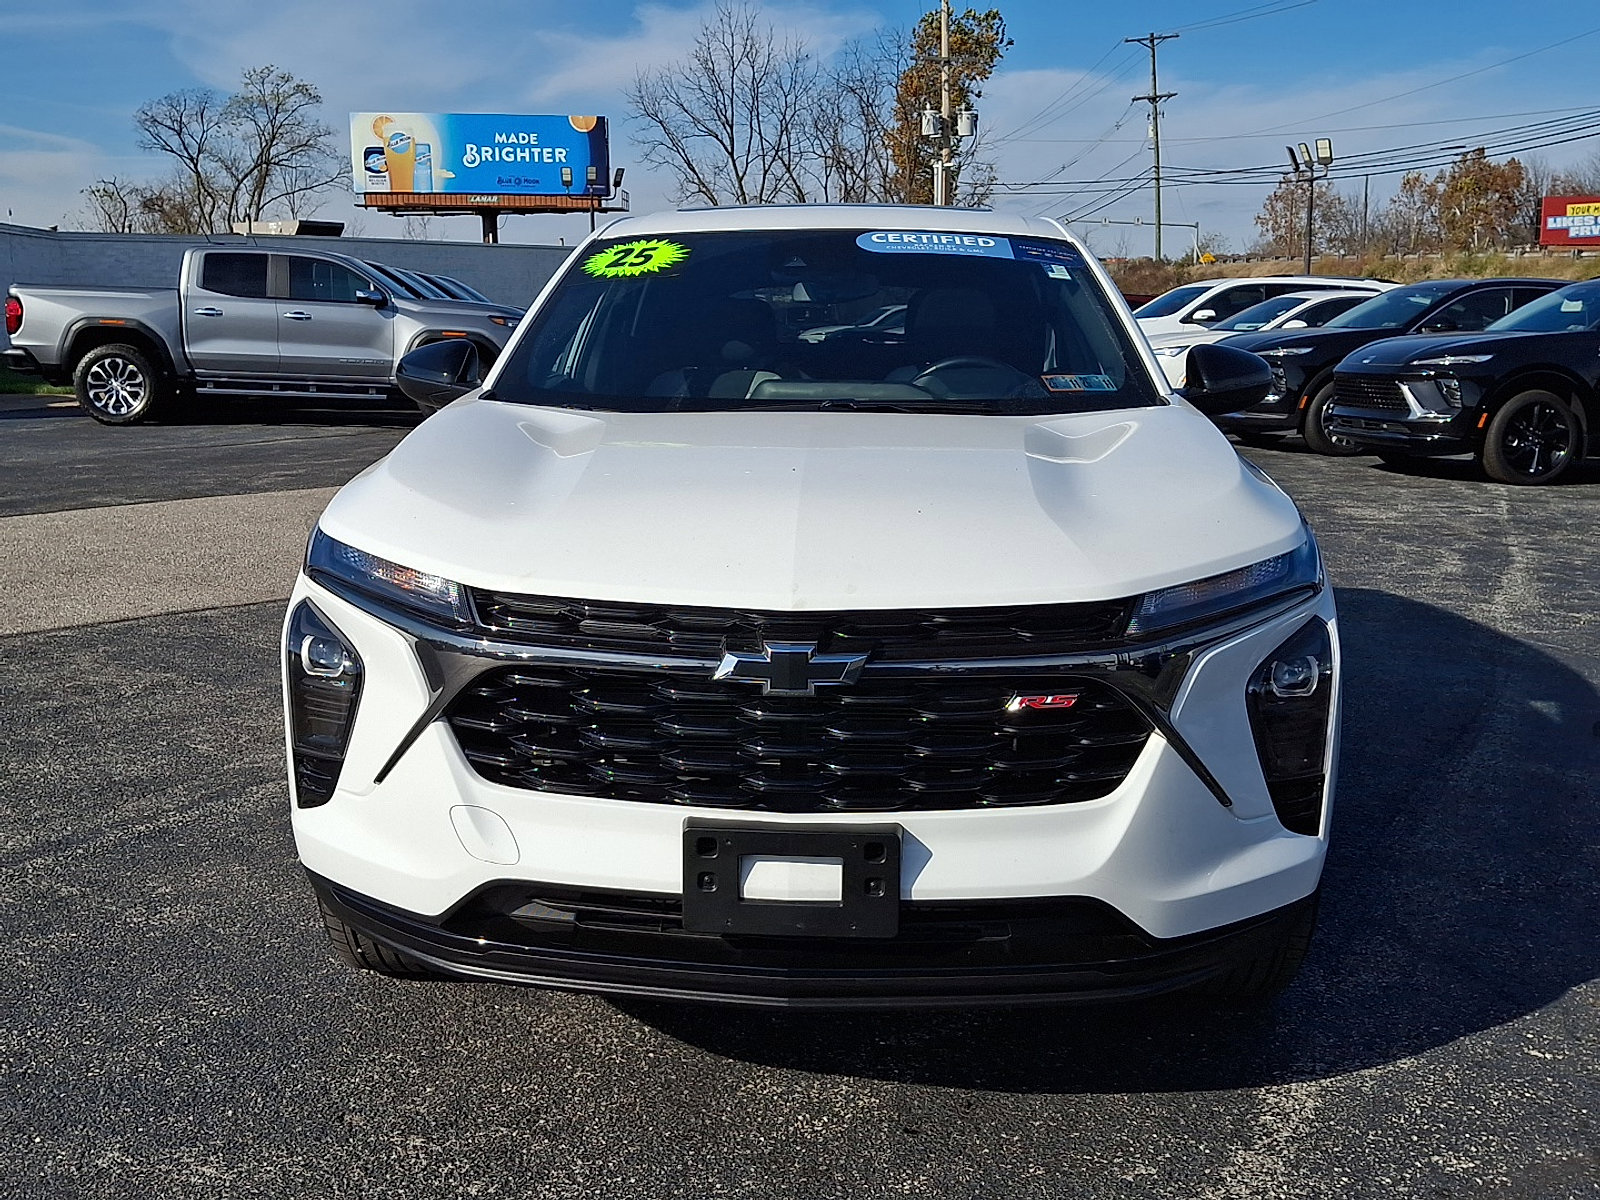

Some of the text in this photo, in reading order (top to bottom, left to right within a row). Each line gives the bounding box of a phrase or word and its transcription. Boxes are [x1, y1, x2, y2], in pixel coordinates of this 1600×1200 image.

[494, 132, 539, 145] MADE
[462, 143, 567, 168] BRIGHTER
[1571, 205, 1592, 216] YOUR
[1547, 216, 1595, 229] LIKES
[871, 233, 996, 247] CERTIFIED
[604, 246, 660, 269] 25
[1019, 694, 1078, 709] RS
